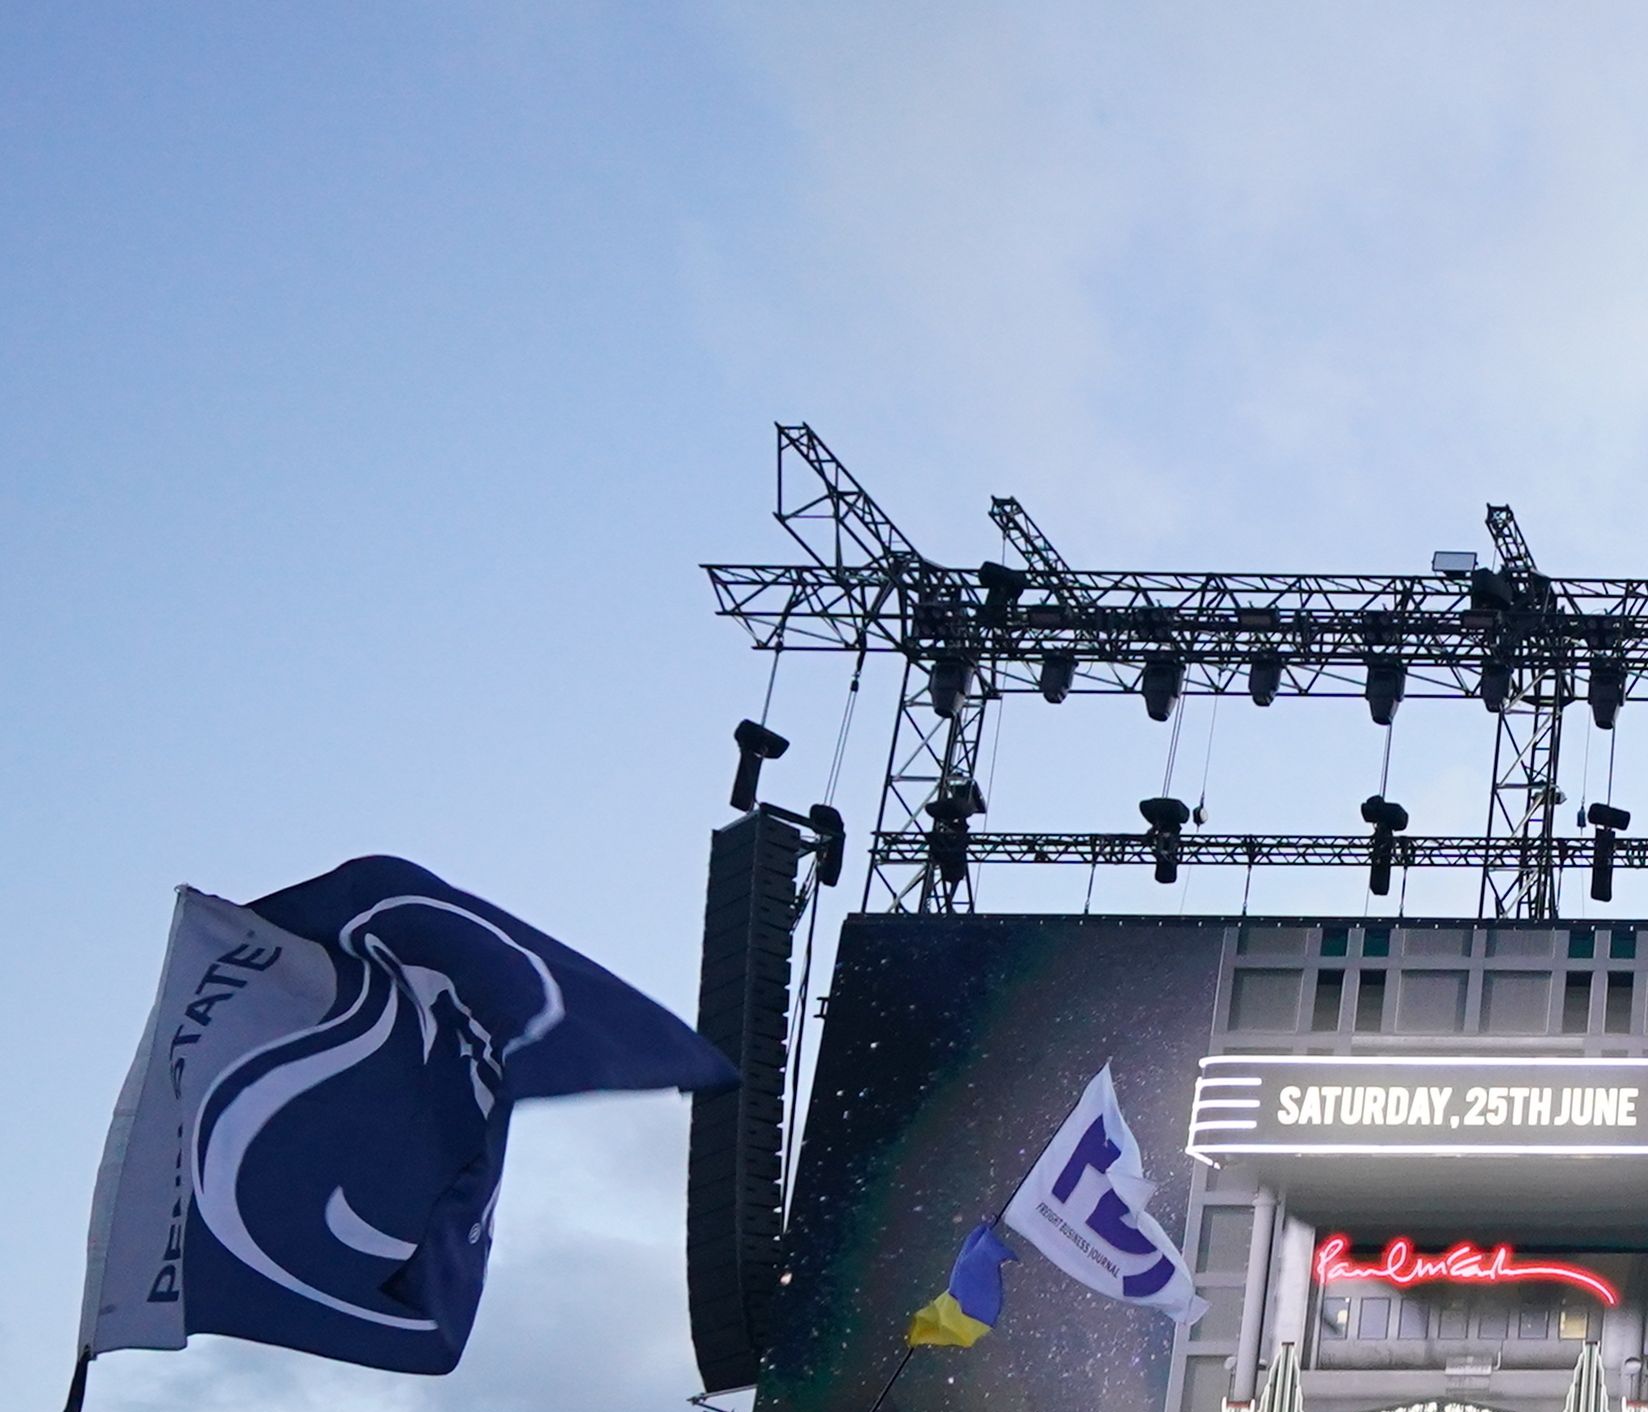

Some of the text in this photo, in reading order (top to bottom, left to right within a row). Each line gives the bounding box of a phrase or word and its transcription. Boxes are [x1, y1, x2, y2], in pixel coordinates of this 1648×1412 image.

[1276, 1085, 1640, 1129] SATURDAY, 25TH JUNE
[1035, 1201, 1063, 1227] FREIGHT
[1058, 1219, 1091, 1254] BUSINESS
[1087, 1245, 1121, 1279] JOURNAL
